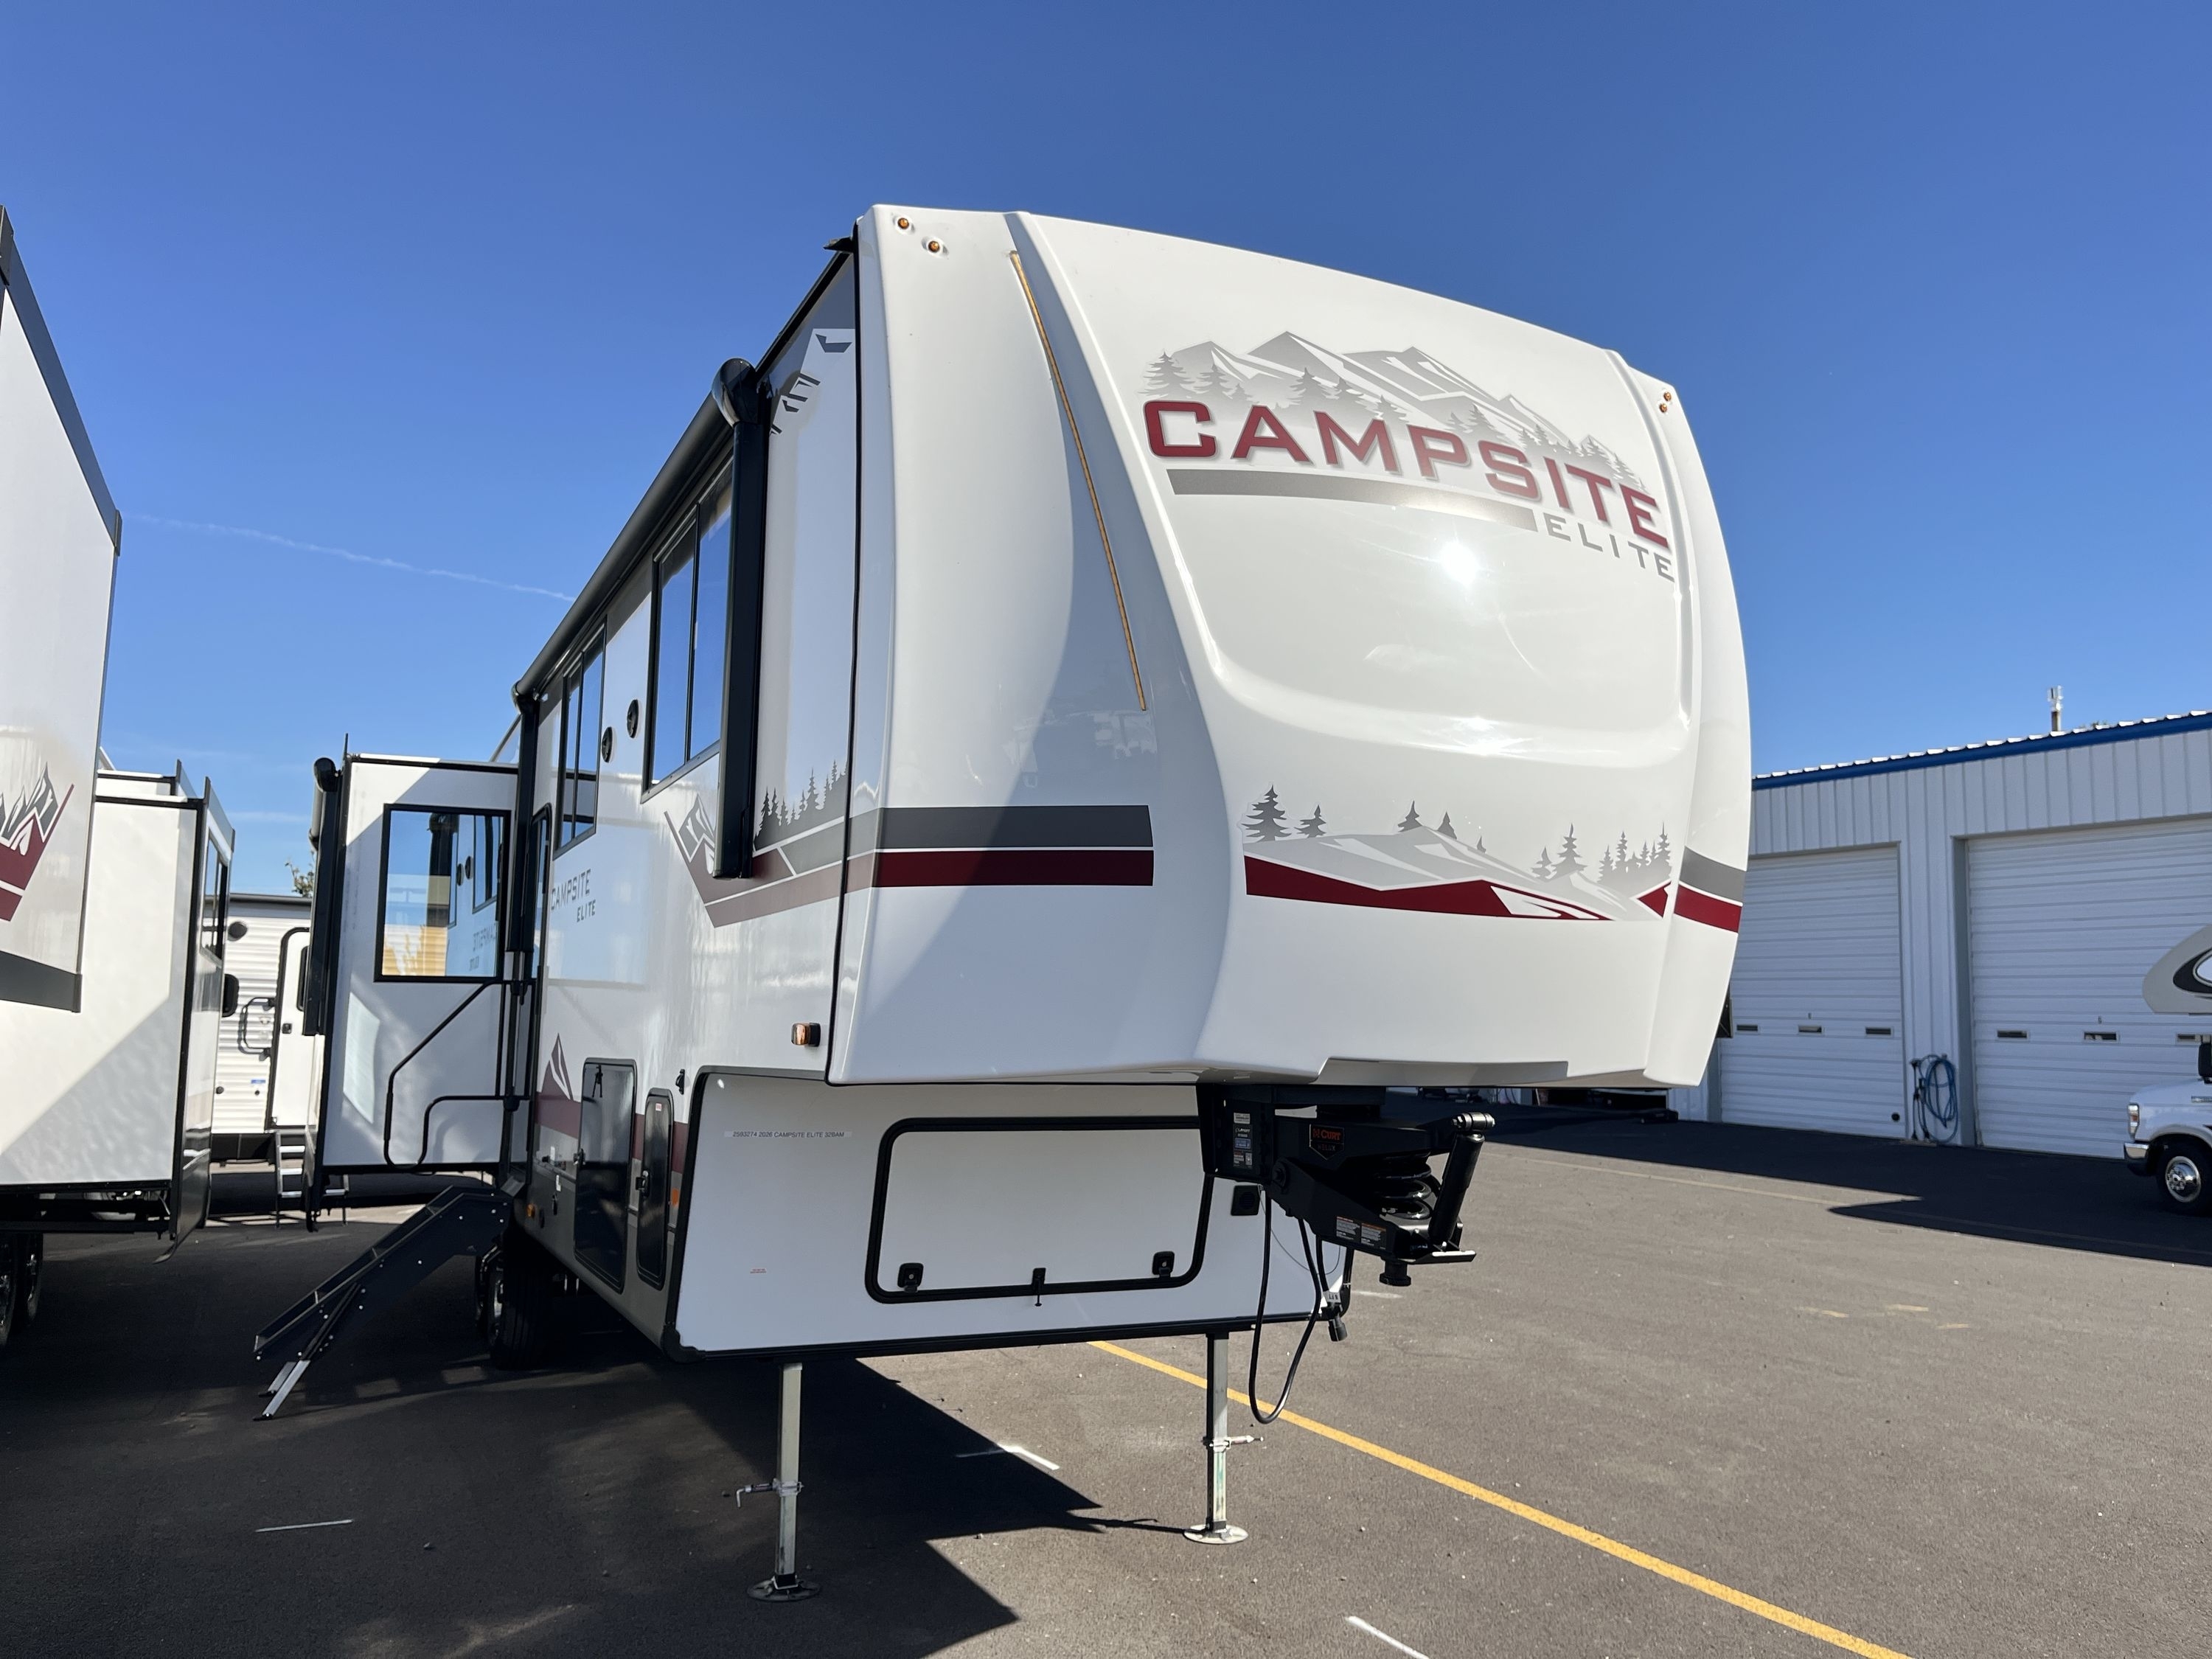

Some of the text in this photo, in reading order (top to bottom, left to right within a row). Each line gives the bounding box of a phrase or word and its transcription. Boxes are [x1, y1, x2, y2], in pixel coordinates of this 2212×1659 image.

[1144, 400, 1672, 552] CAMPSITE
[1543, 512, 1674, 582] ELITE
[551, 869, 591, 911] CAMPSITE
[577, 899, 597, 923] ELITE
[1321, 1129, 1341, 1141] CURT
